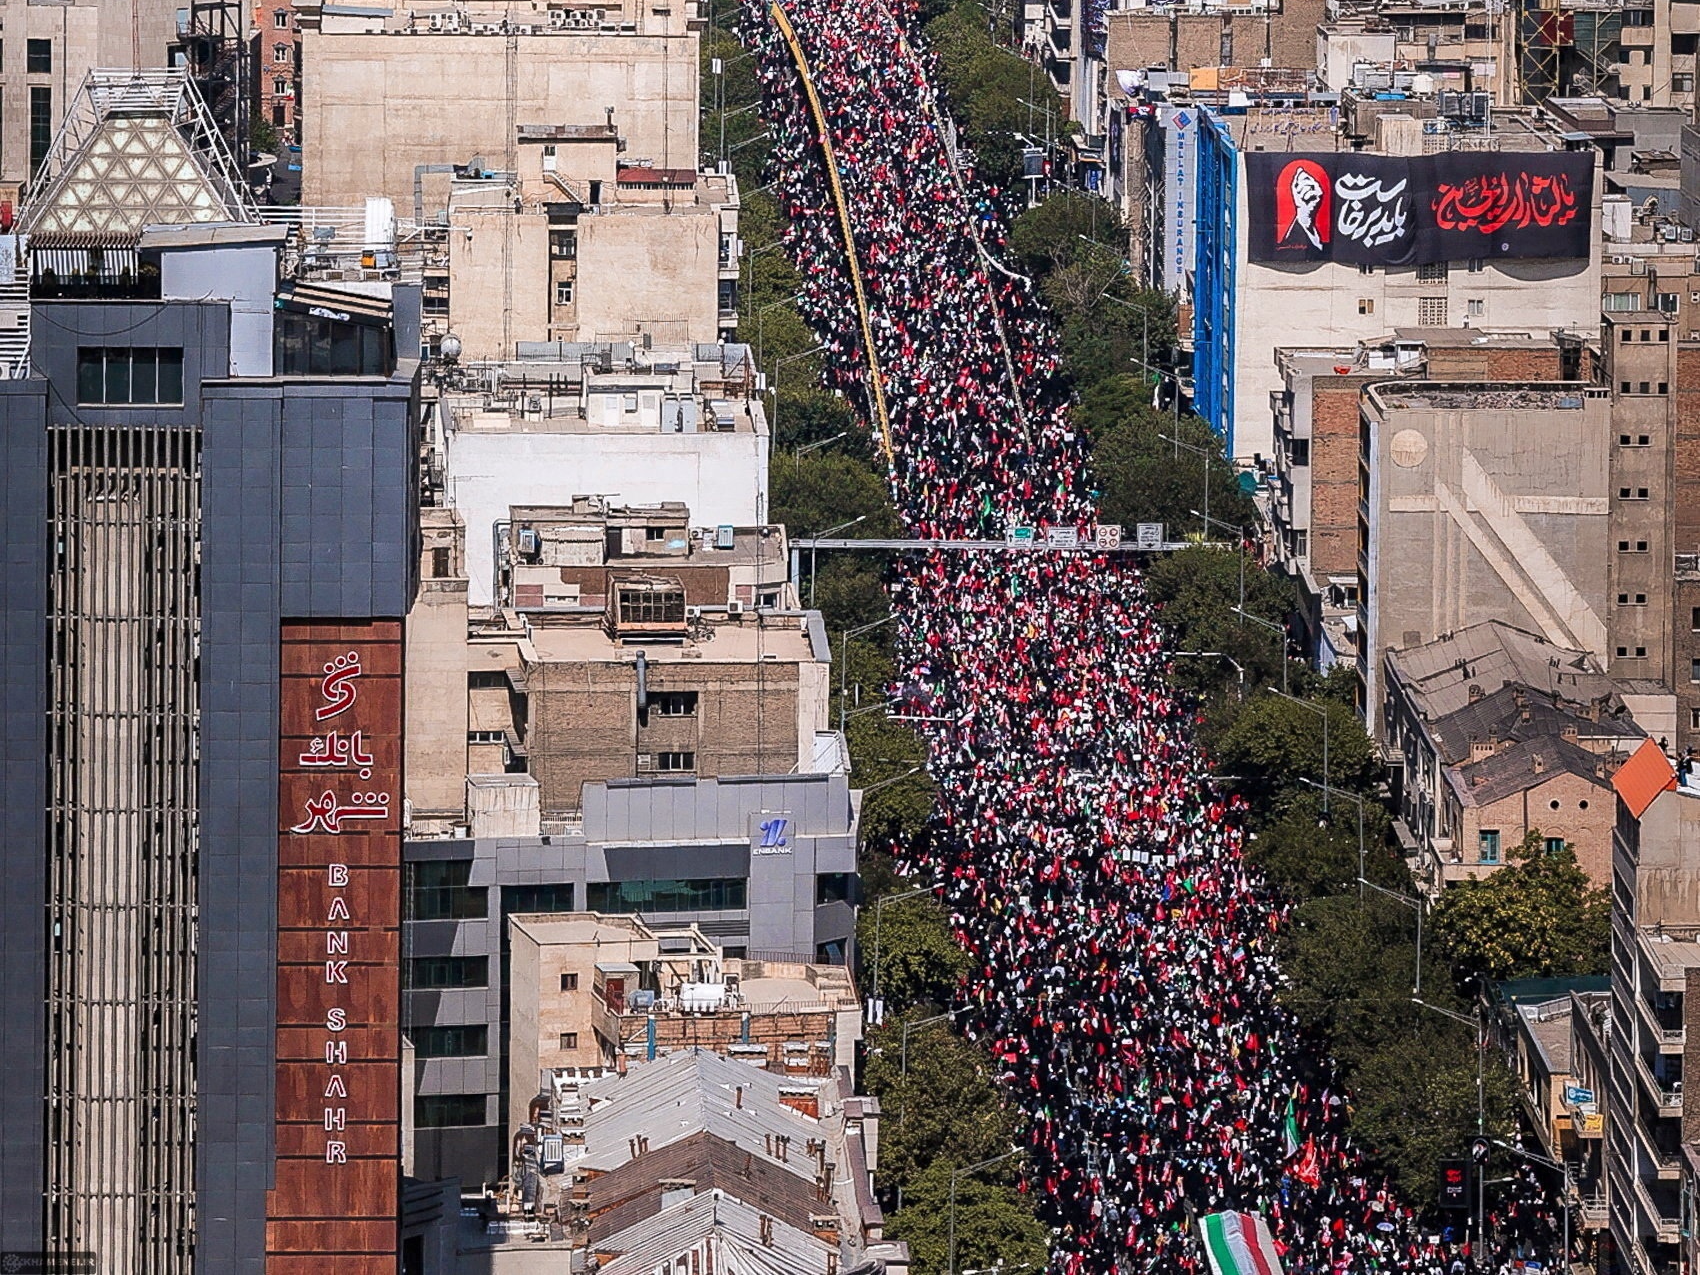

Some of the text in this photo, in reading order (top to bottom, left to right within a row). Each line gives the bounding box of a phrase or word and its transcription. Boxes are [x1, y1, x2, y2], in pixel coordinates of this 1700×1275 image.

[1176, 132, 1185, 274] MELLAT INSURANCE
[290, 789, 389, 834] شهر
[324, 863, 349, 1163] BANK SHAHR
